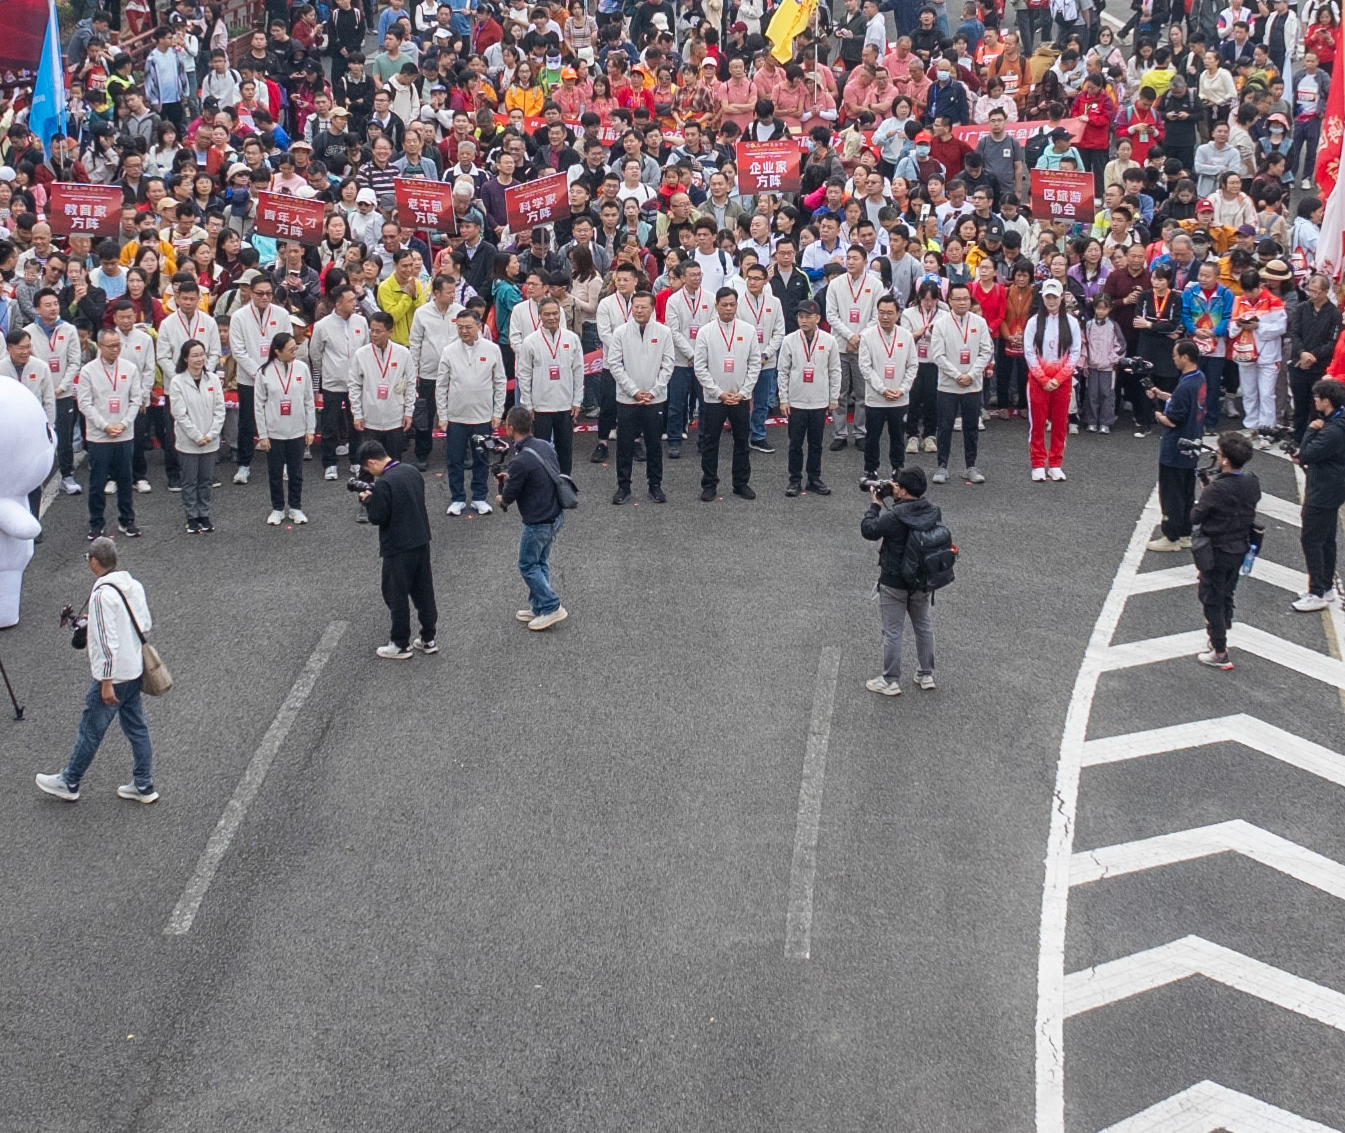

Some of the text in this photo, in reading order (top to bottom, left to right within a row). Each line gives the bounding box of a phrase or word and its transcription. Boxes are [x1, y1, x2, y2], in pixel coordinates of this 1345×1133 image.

[749, 160, 788, 175] 企业家
[756, 175, 781, 188] 方阵
[519, 192, 557, 213] 科学家
[1043, 188, 1082, 203] 区旅游
[64, 203, 107, 218] 教育家
[407, 197, 443, 212] 老干部
[1050, 202, 1076, 216] 协会
[264, 208, 317, 229] 青年人才
[415, 211, 439, 225] 方阵
[526, 206, 552, 224] 方阵
[70, 217, 100, 230] 方阵
[276, 223, 303, 237] 方阵
